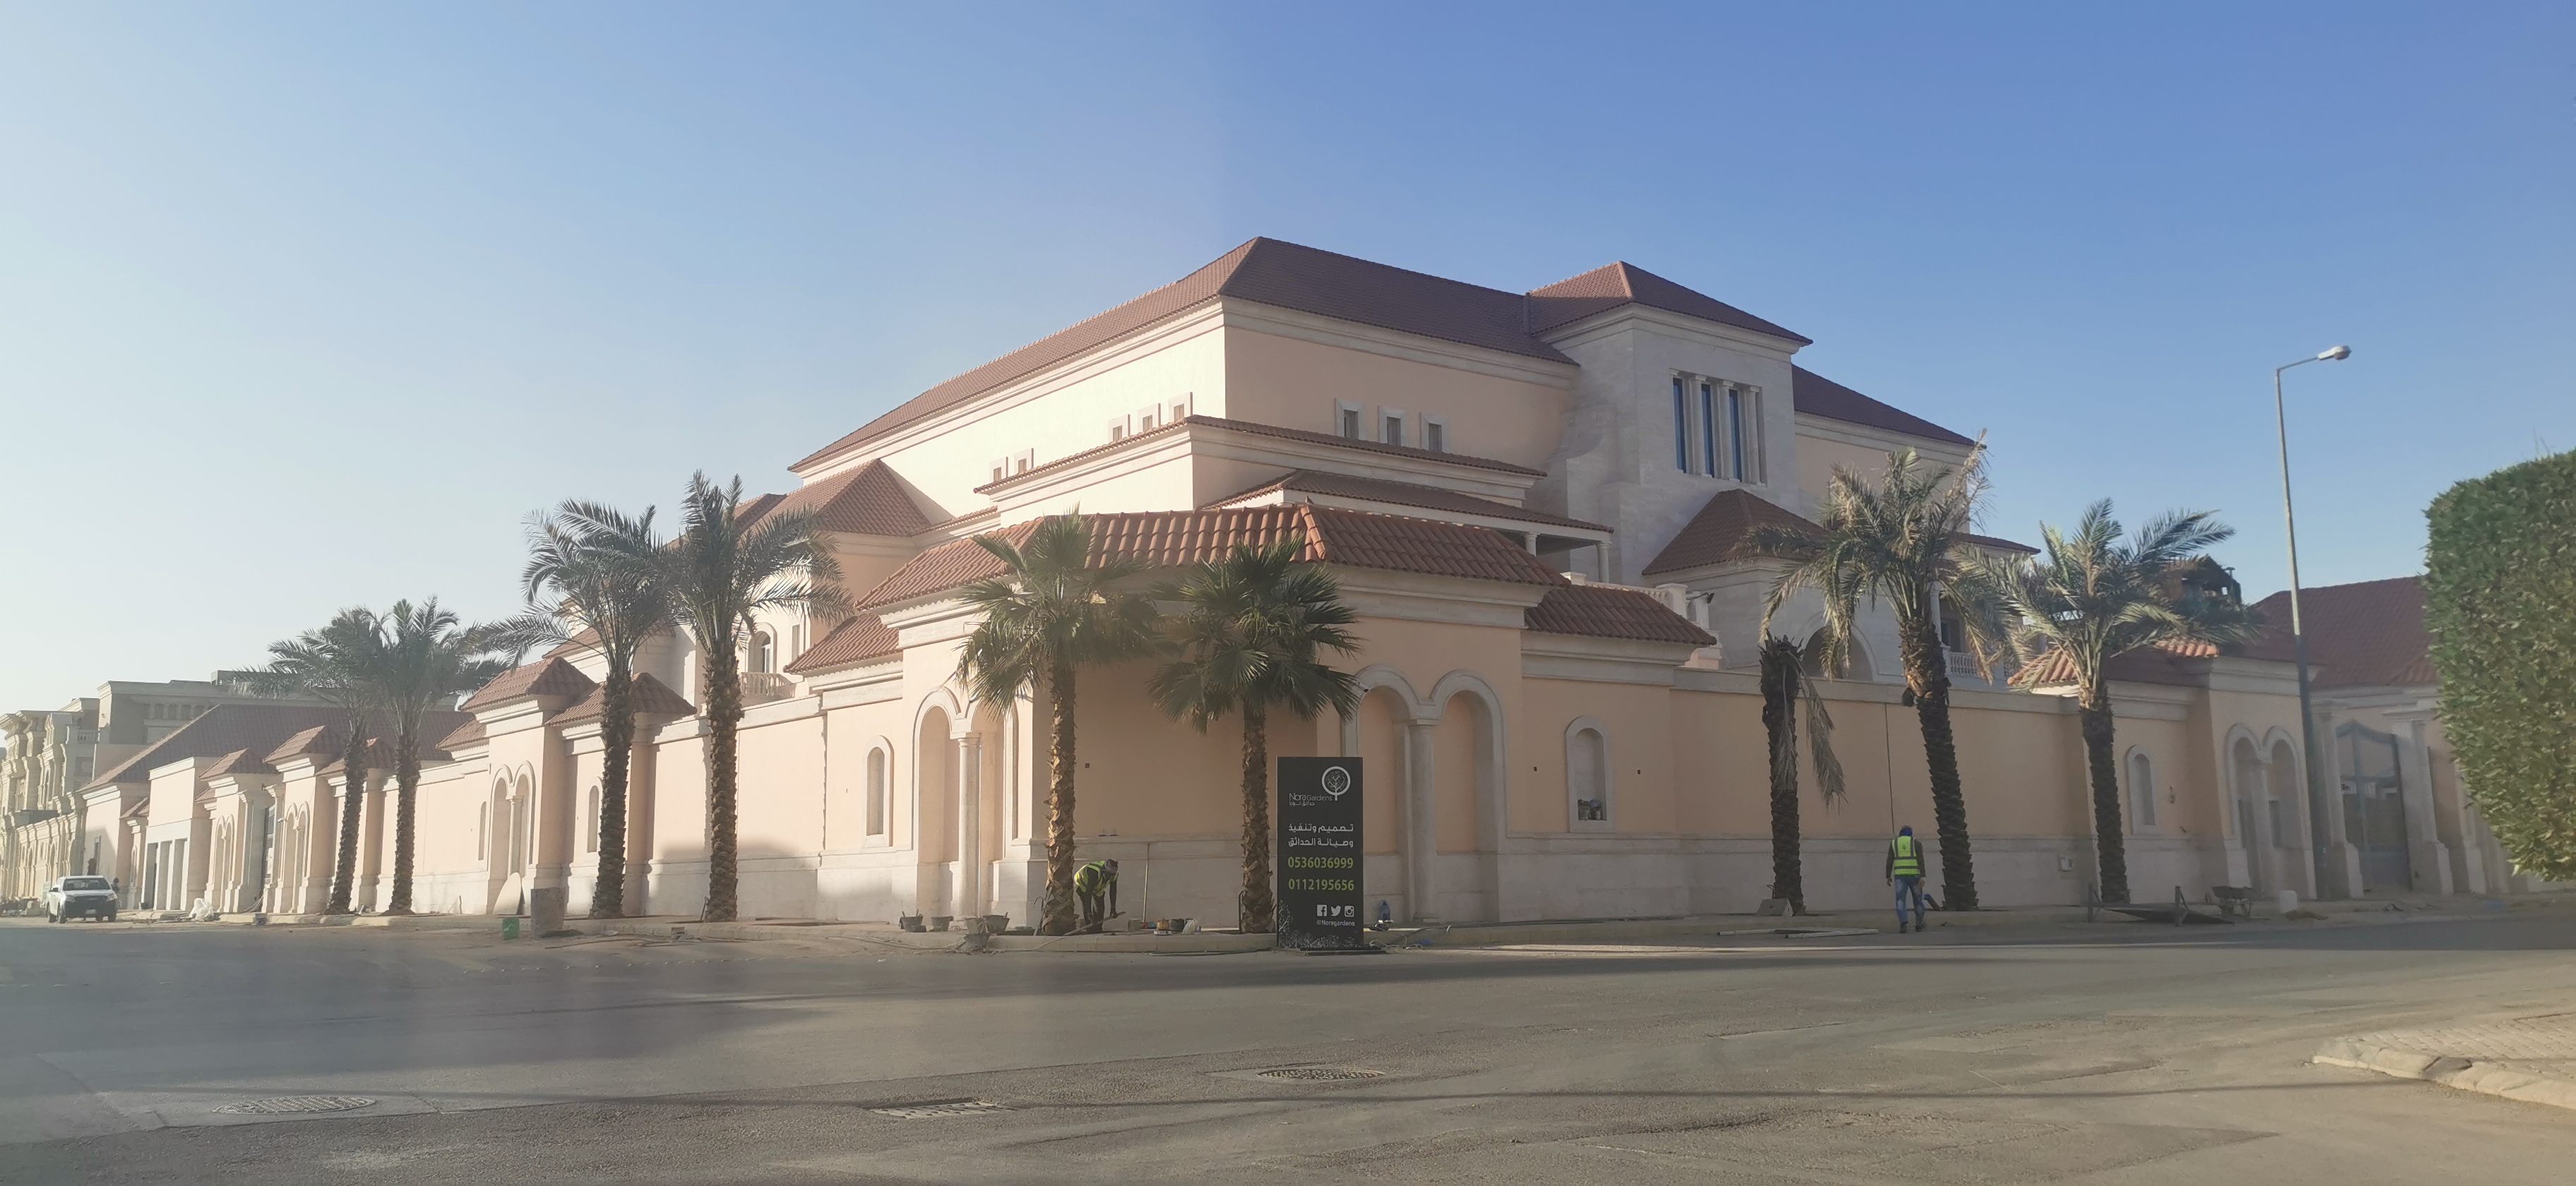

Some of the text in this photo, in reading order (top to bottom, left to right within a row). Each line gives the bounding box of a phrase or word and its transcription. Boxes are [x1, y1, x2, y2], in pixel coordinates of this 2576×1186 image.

[1288, 822, 1354, 833] تصميم وتنفيذ
[1288, 836, 1354, 849] وصيانة الحدائق
[1287, 856, 1354, 869] 0536036999
[1288, 878, 1354, 891] 0112195656
